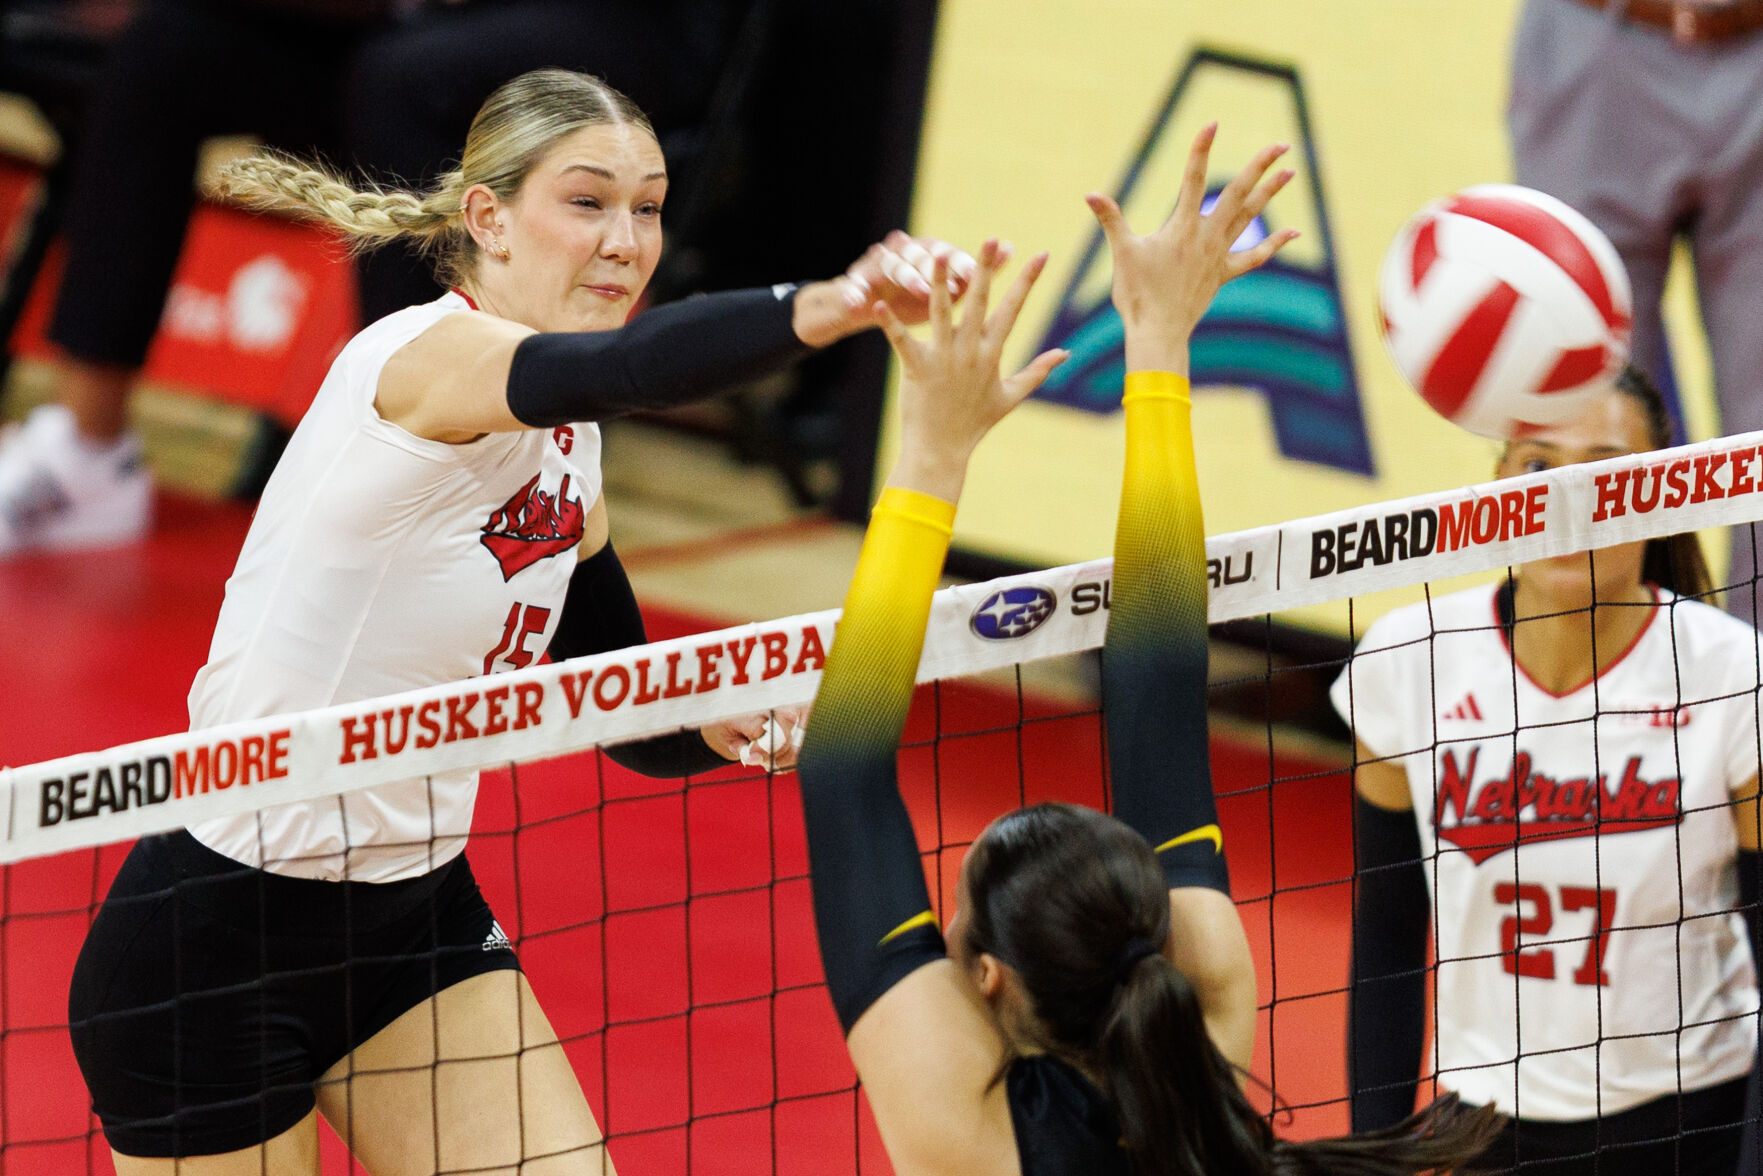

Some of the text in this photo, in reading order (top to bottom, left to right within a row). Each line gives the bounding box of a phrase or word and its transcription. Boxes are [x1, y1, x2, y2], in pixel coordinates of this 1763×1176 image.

[1591, 445, 1763, 523] HUSKE
[1309, 484, 1549, 579] BEARDMORE
[1070, 551, 1253, 616] SRU
[483, 601, 551, 676] 15
[338, 620, 841, 765] HUSKER VOLLEYBA
[39, 729, 292, 828] BEARDMORE
[1432, 746, 1685, 829] Nebraska
[1494, 882, 1618, 987] 27
